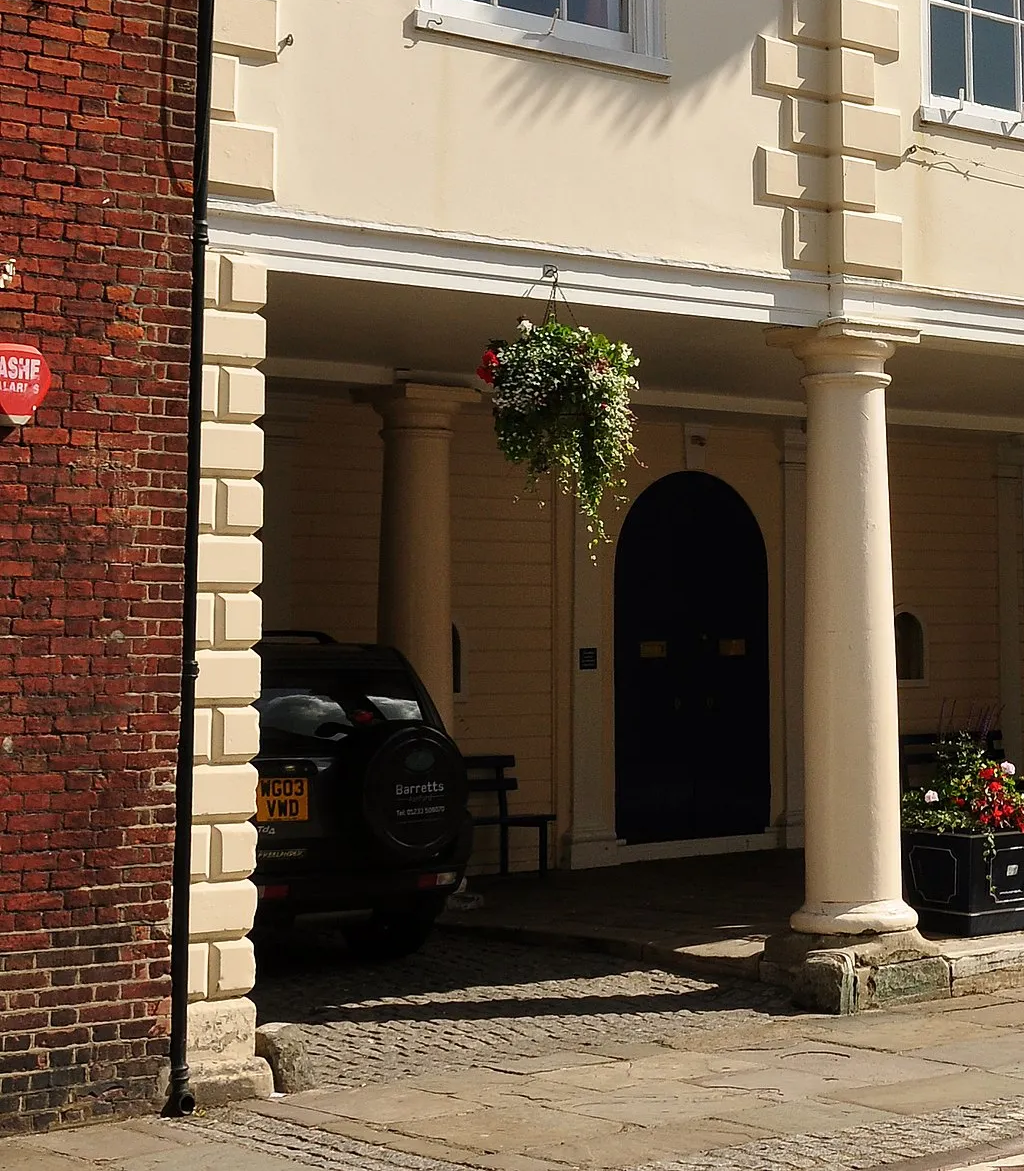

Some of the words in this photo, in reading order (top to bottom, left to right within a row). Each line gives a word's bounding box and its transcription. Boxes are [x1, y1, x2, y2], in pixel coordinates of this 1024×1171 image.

[260, 779, 305, 798] WG03
[395, 781, 445, 795] Barretts
[266, 799, 299, 817] VWD
